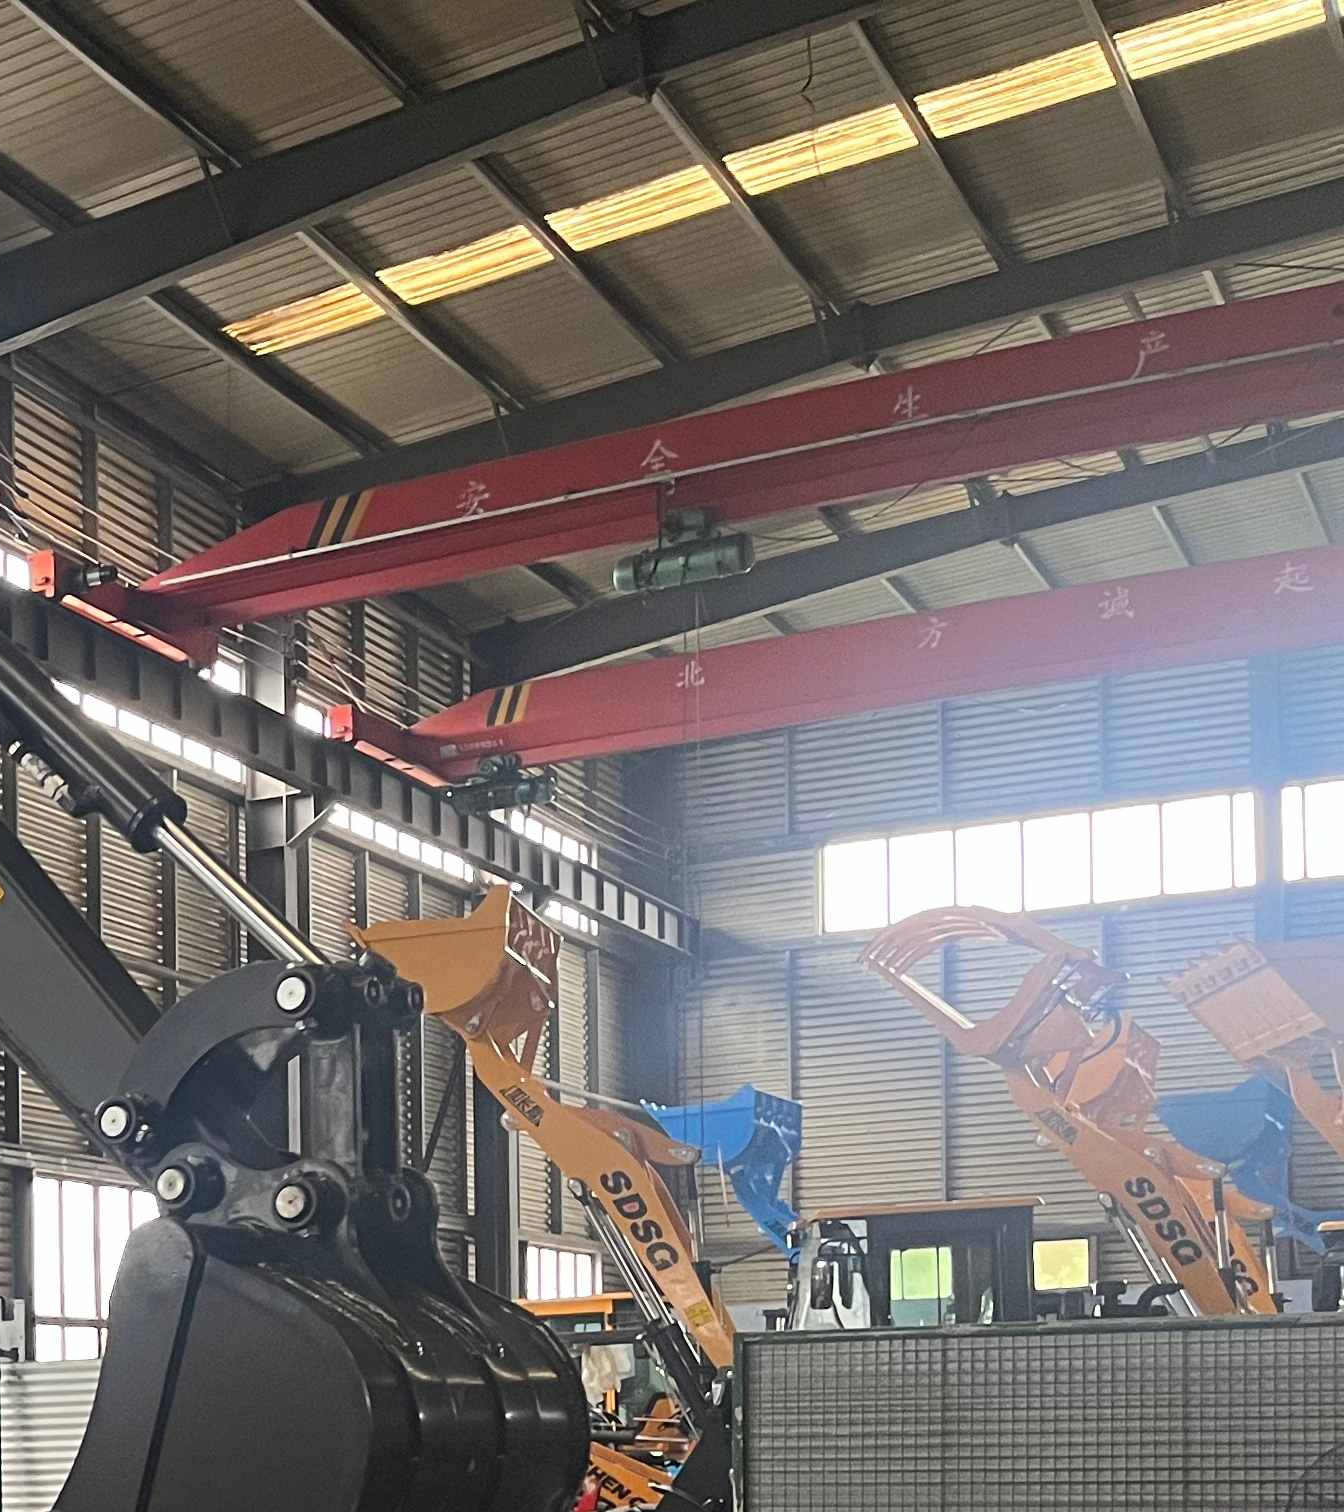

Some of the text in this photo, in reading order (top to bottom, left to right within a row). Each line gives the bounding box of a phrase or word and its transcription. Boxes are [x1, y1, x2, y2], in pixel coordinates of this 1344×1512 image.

[600, 1170, 679, 1271] SDSG
[1124, 1176, 1202, 1266] SDSG
[586, 1462, 648, 1508] HEN
